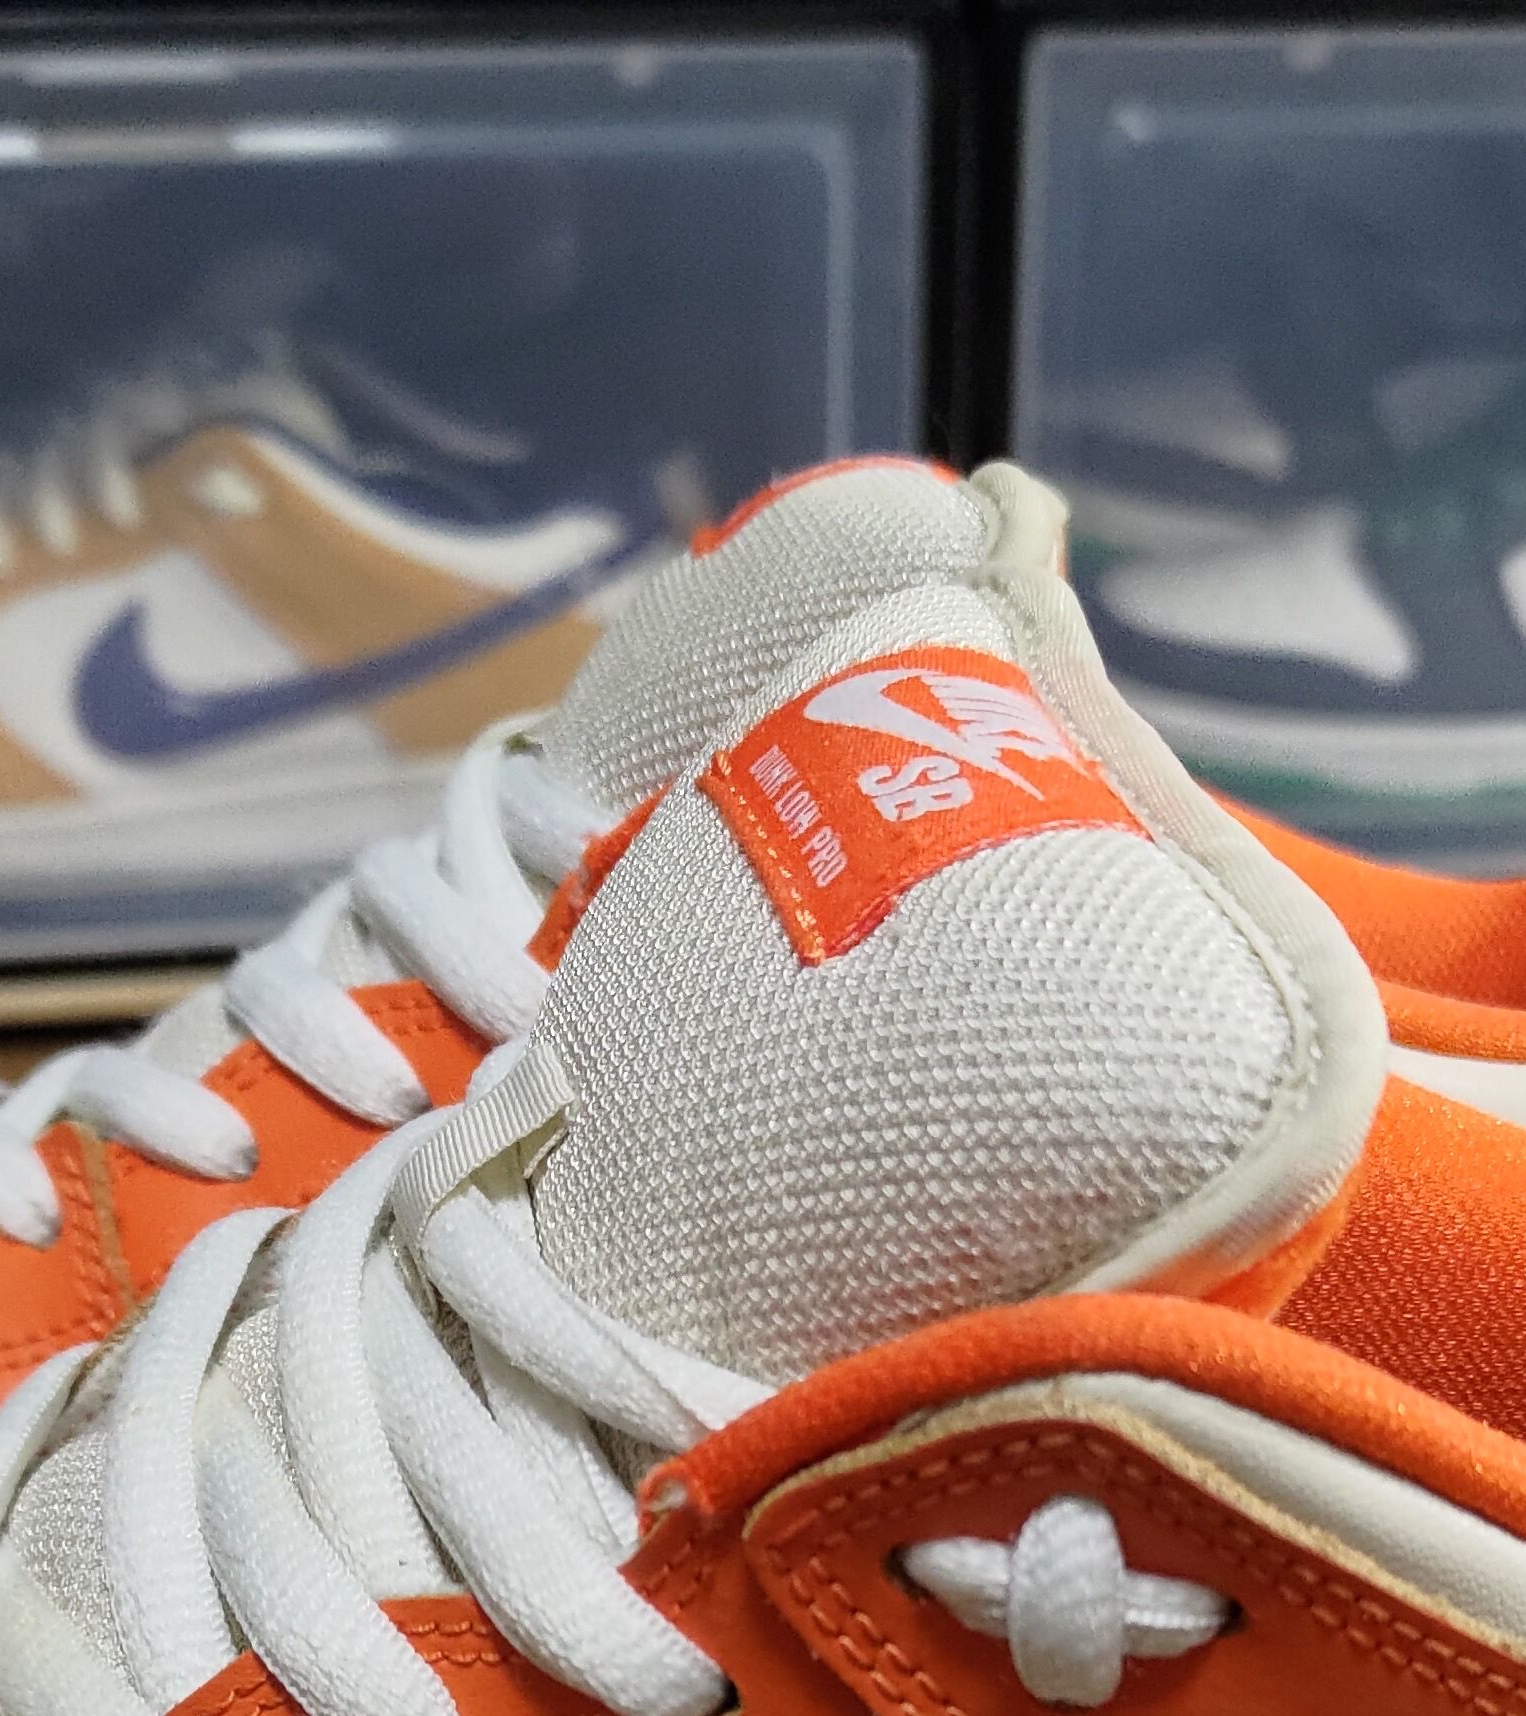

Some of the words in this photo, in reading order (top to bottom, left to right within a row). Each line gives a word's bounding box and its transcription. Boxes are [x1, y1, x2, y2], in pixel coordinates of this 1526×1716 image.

[858, 755, 974, 822] SB
[775, 780, 823, 841] LOW
[800, 825, 848, 888] PRO
